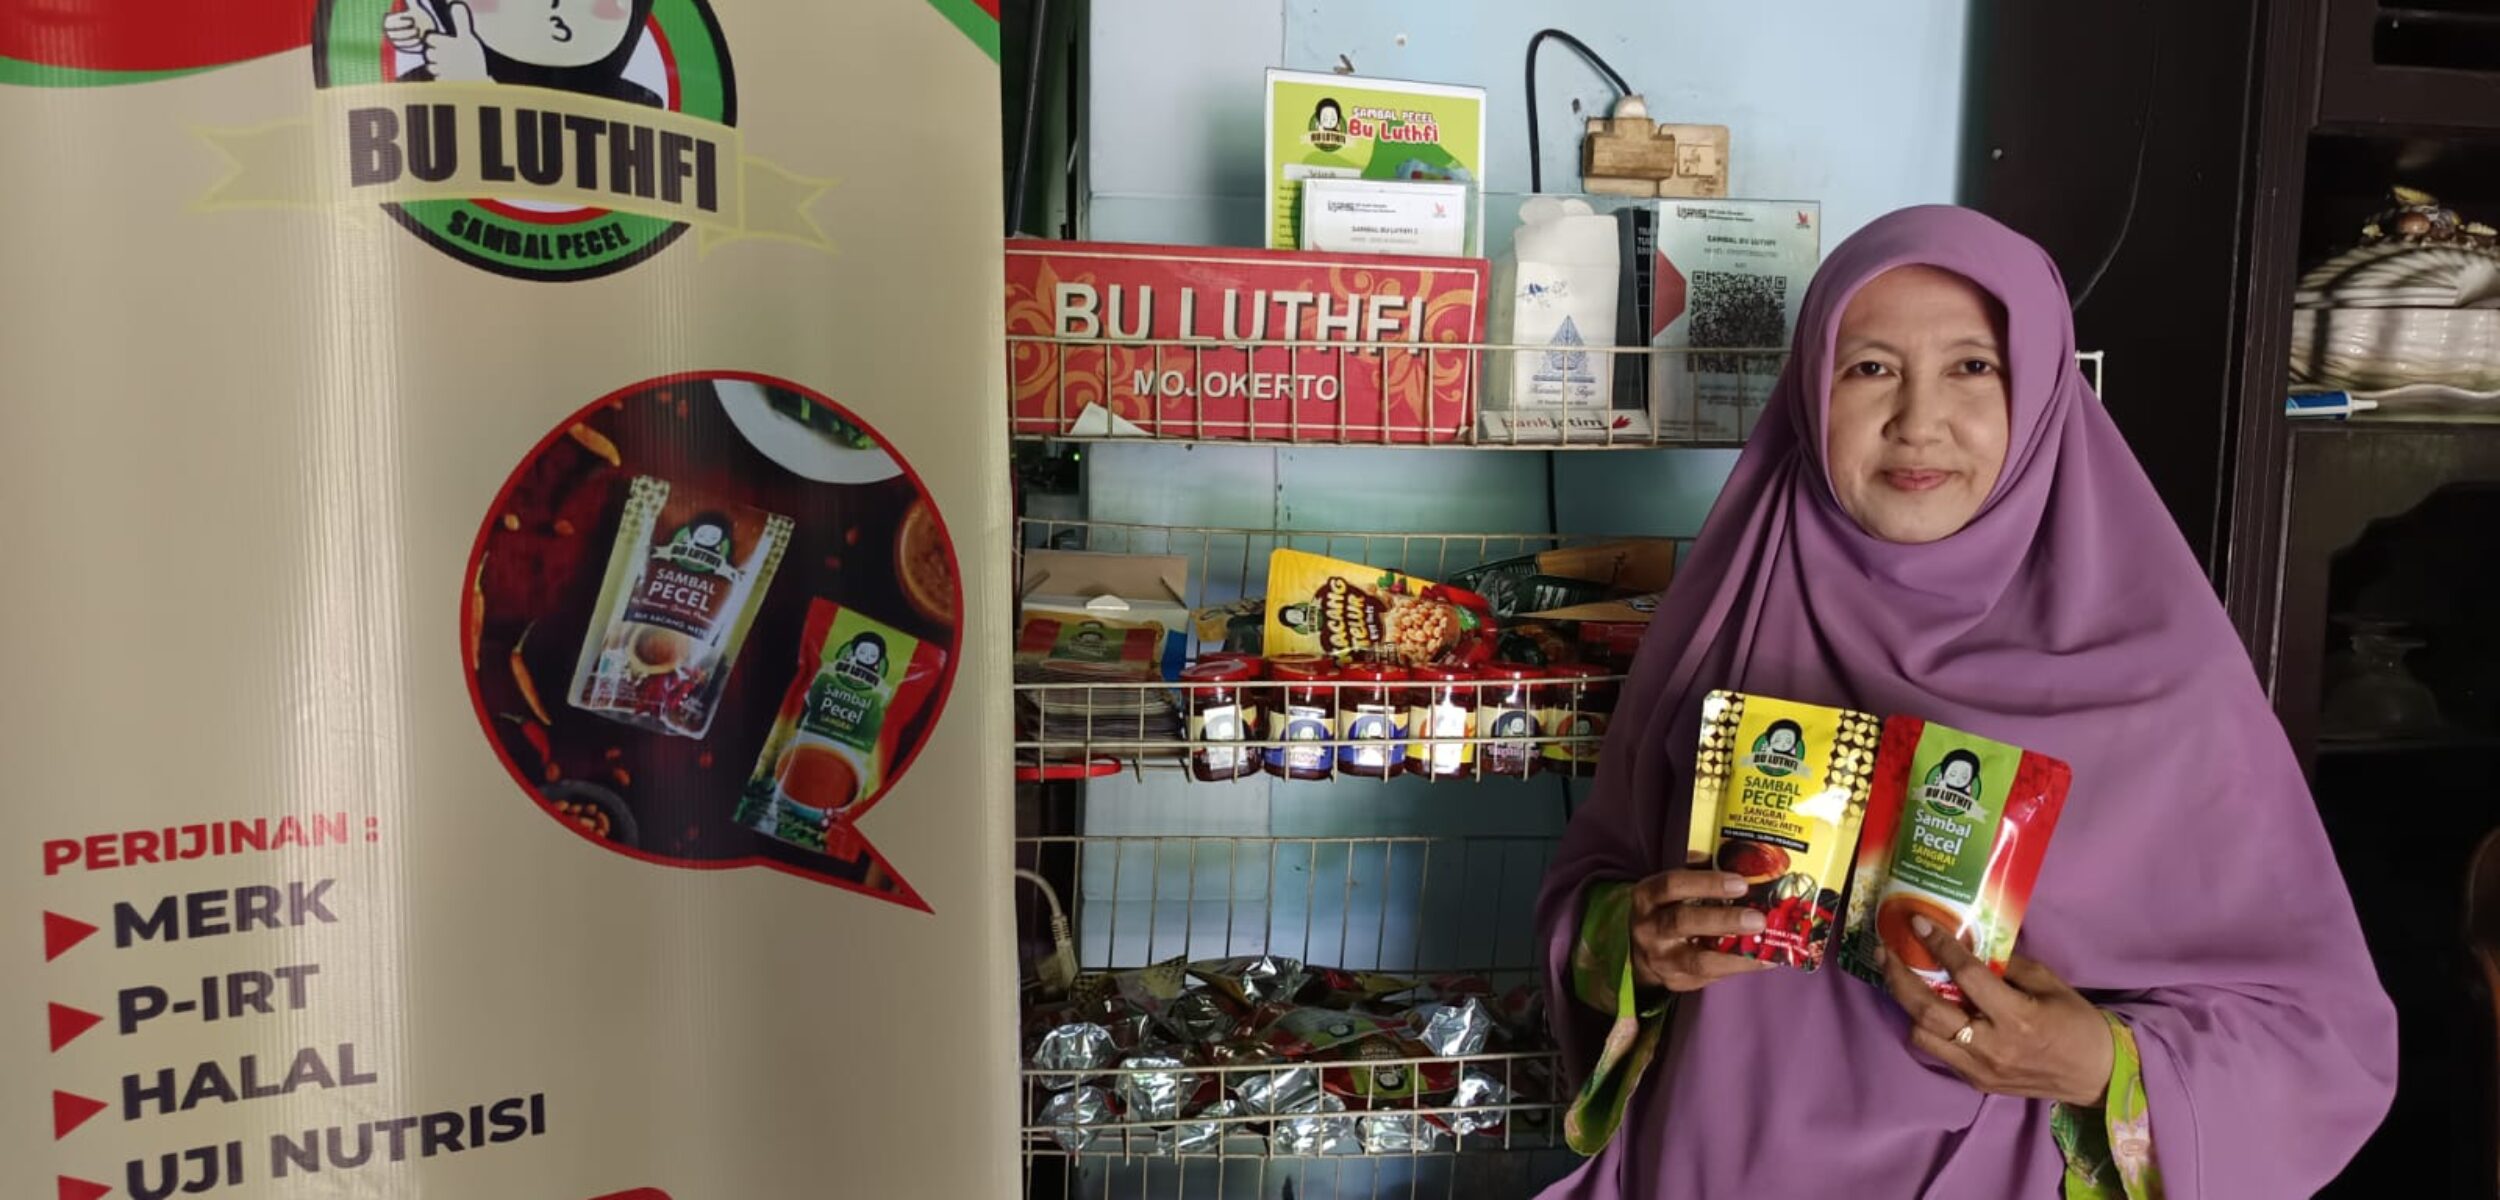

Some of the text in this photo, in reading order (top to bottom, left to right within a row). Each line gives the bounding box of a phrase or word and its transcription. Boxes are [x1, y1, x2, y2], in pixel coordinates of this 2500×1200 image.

[1353, 106, 1397, 120] SAMBAL
[1348, 119, 1439, 142] Bu Luthfi
[349, 103, 718, 213] BU LUTHFI
[447, 209, 631, 261] SAMBAL PECEL
[1055, 281, 1426, 356] BU LUTHFI
[648, 580, 710, 612] PECEL
[656, 568, 716, 596] SAMBAL
[820, 697, 865, 725] Pecel
[824, 683, 873, 710] Sambal
[1743, 775, 1802, 797] SAMBAL
[1744, 806, 1787, 821] SANGRAI
[1915, 808, 1972, 838] Sambal
[43, 811, 348, 876] PERIJINAN
[1911, 843, 1957, 867] SANGRAI
[1913, 825, 1964, 856] Pecel
[113, 878, 339, 949] MERK
[118, 964, 320, 1035] P-IRT
[121, 1043, 378, 1121] HALAL
[126, 1092, 547, 1200] UJI NUTRISI
